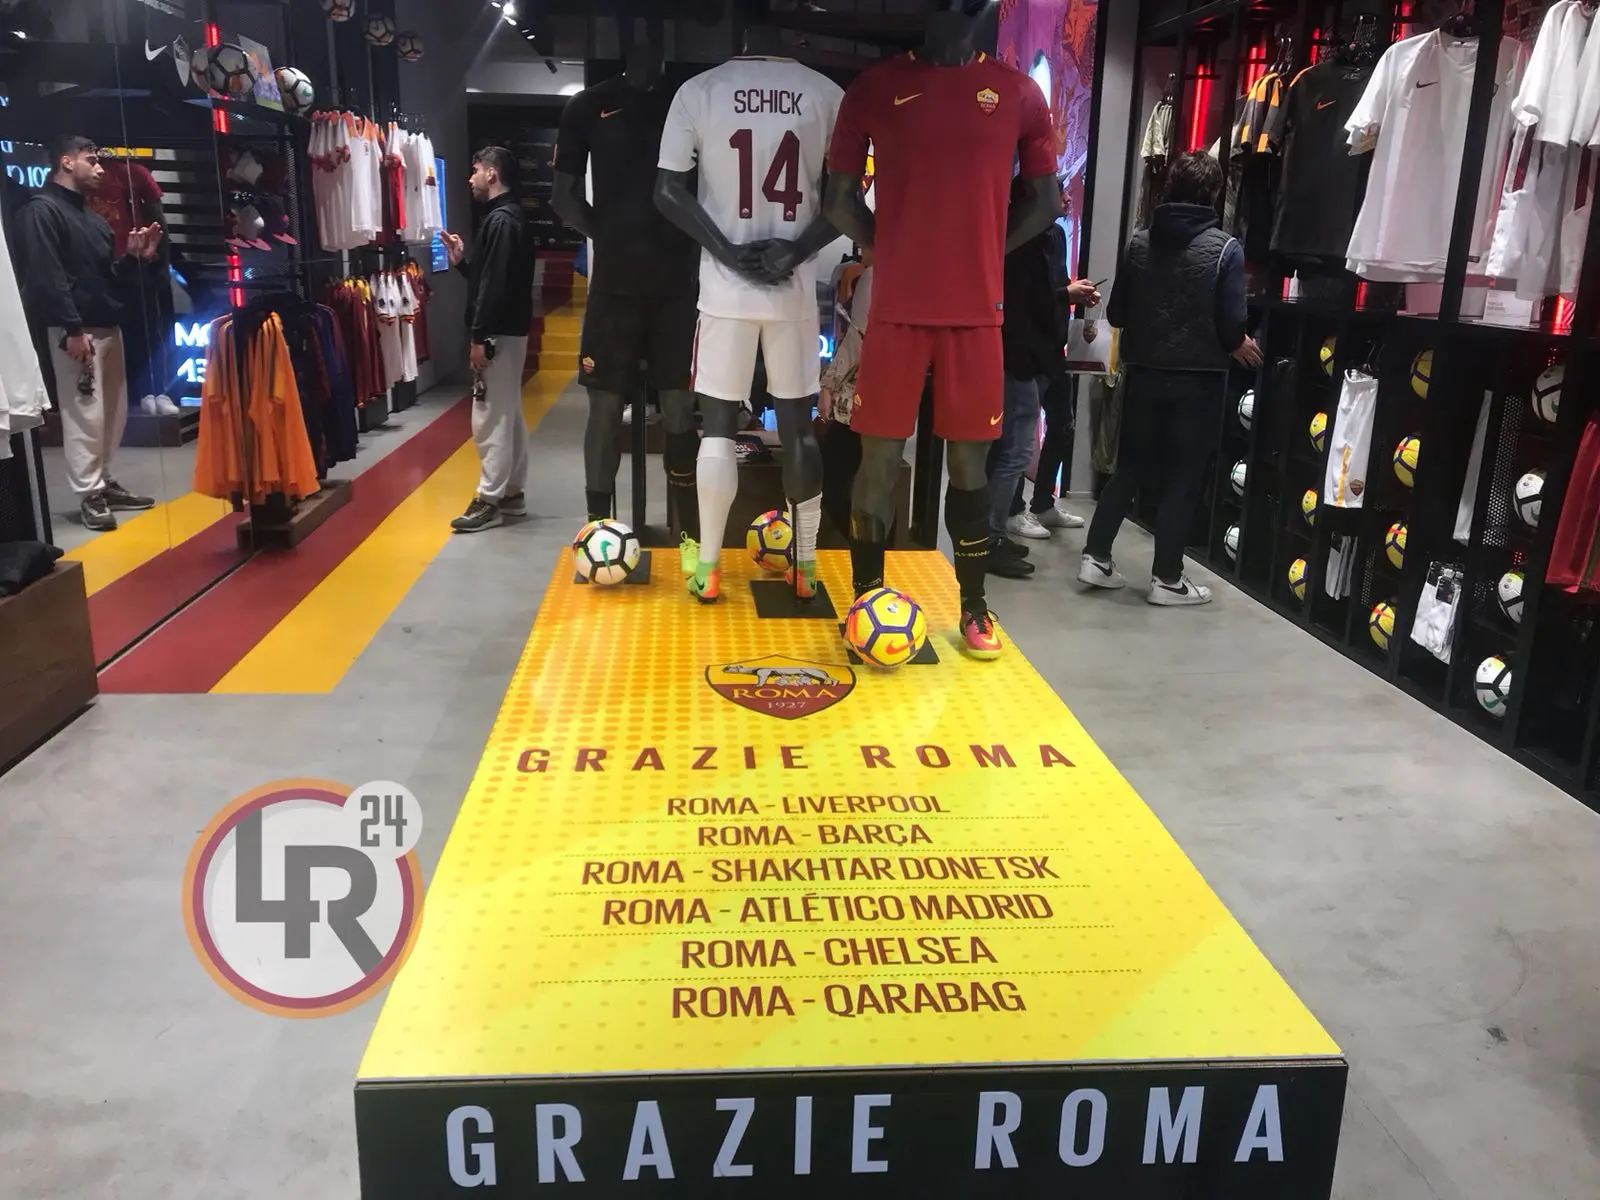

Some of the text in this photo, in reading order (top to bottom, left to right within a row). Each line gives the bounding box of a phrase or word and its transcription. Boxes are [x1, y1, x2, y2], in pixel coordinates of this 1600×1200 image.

[734, 88, 804, 116] SCHICK
[728, 128, 804, 222] 14
[731, 688, 838, 699] ROMA
[767, 701, 808, 709] 1927
[516, 743, 1077, 773] GRAZIE ROMA
[667, 797, 759, 816] ROMA
[782, 794, 951, 815] LIVERPOOL
[698, 825, 795, 847] ROMA
[818, 823, 933, 847] BARÇA
[582, 859, 686, 885] ROMA
[711, 856, 896, 883] SHAKHTAR
[904, 855, 1061, 880] DONETSK
[603, 897, 712, 926] ROMA
[739, 892, 905, 924] ATLÉTICO
[912, 893, 1054, 921] MADRID
[681, 938, 797, 969] ROMA
[823, 935, 998, 967] CHELSEA
[672, 985, 796, 1019] ROMA
[824, 980, 1027, 1018] QARABAG
[445, 1083, 1285, 1188] GRAZIE ROMA
